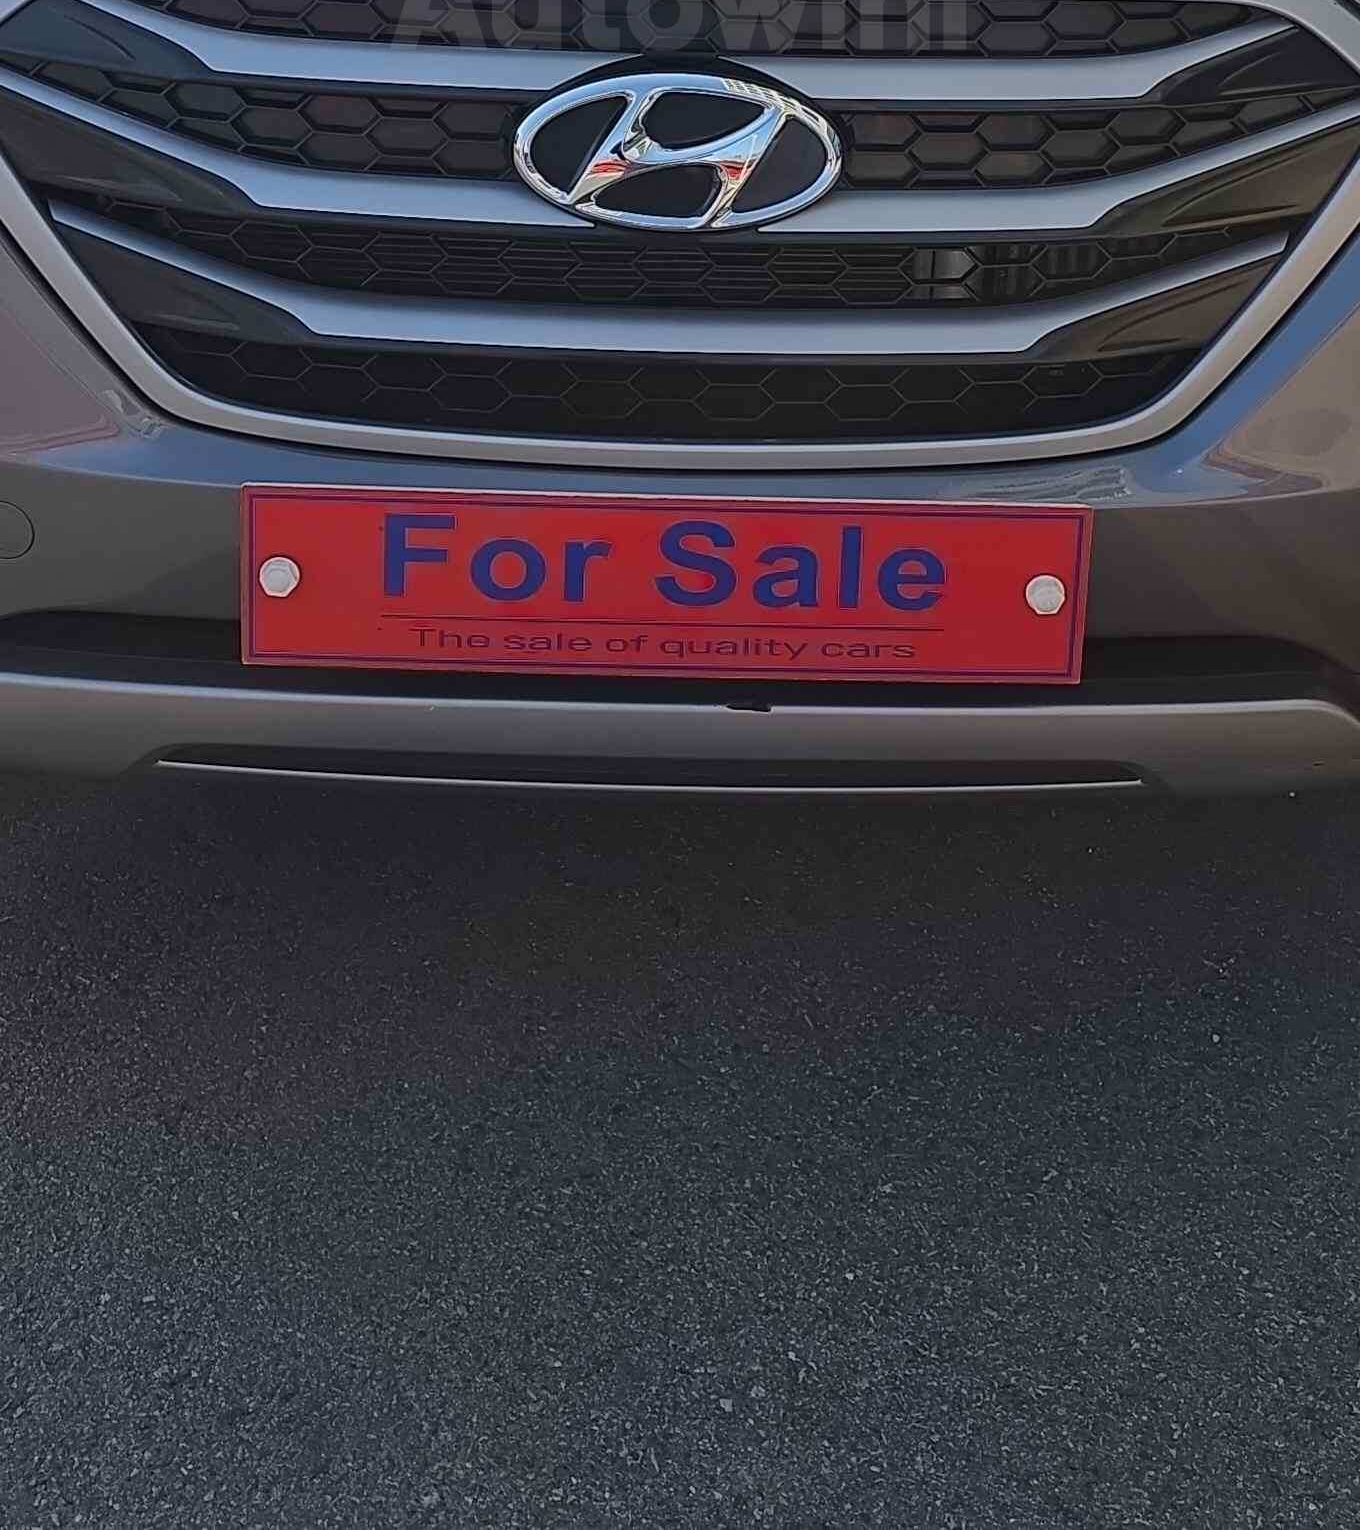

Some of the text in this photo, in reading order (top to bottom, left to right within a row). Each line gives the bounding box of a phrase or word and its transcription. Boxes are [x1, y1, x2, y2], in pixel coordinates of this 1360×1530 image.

[383, 512, 947, 615] For Sale
[411, 627, 917, 660] The sale of quality cars
